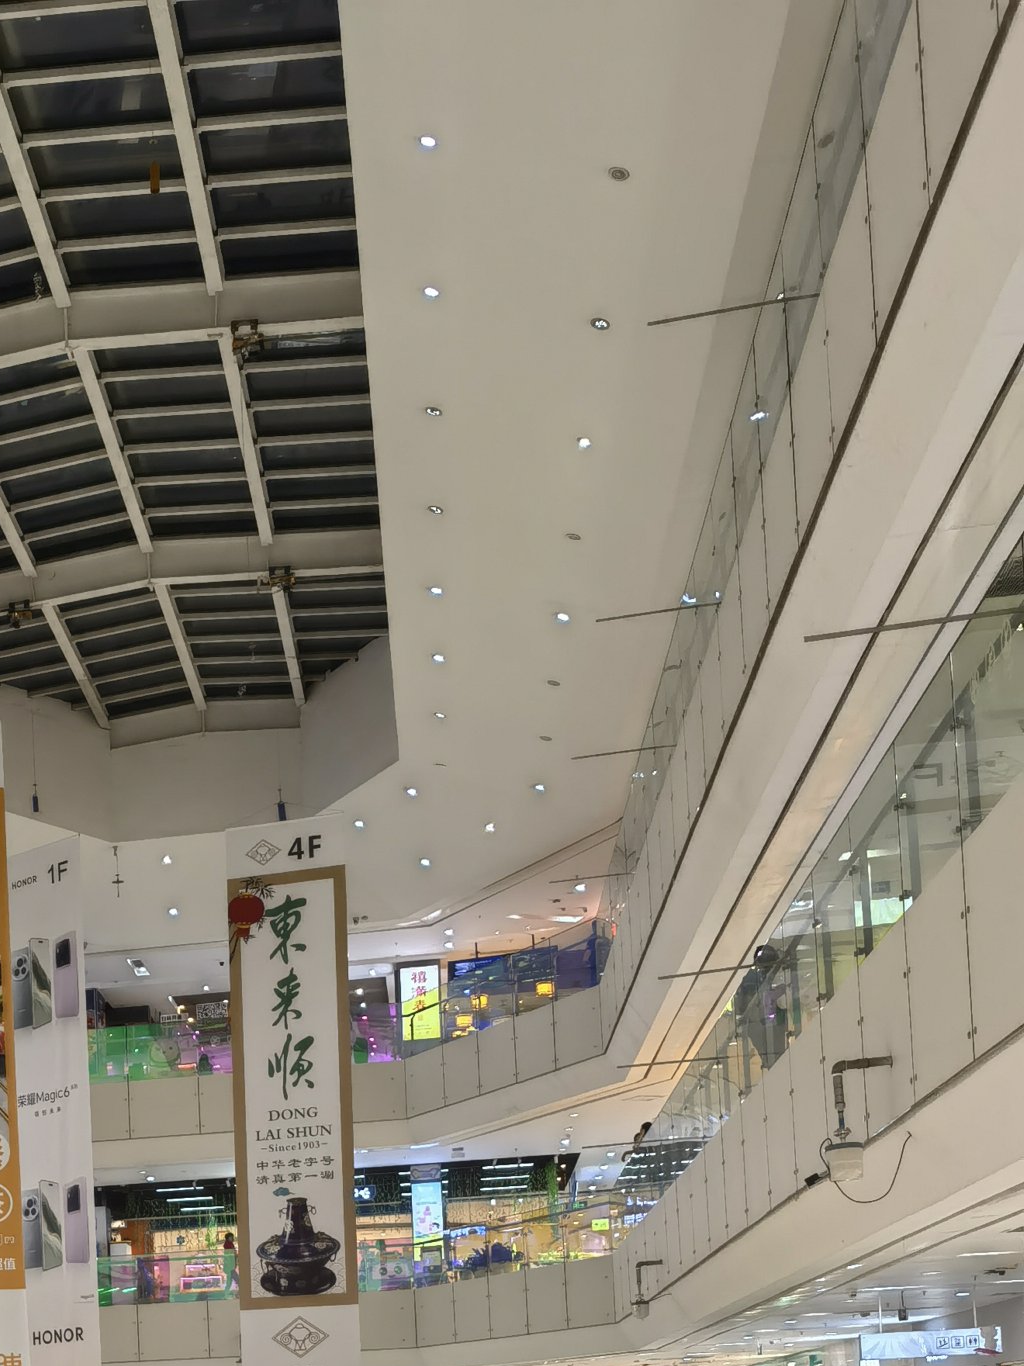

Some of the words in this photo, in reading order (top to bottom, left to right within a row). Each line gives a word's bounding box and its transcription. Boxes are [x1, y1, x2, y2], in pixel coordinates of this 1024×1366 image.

[287, 834, 322, 860] 4F
[12, 875, 37, 890] HONOR
[47, 860, 69, 884] 1F
[268, 1106, 319, 1122] DONG
[256, 1128, 282, 1142] LAI
[286, 1124, 333, 1140] SHUN
[257, 1156, 334, 1170] 中华老字号
[256, 1170, 334, 1184] 清真第一涮
[32, 1327, 84, 1345] HONOR
